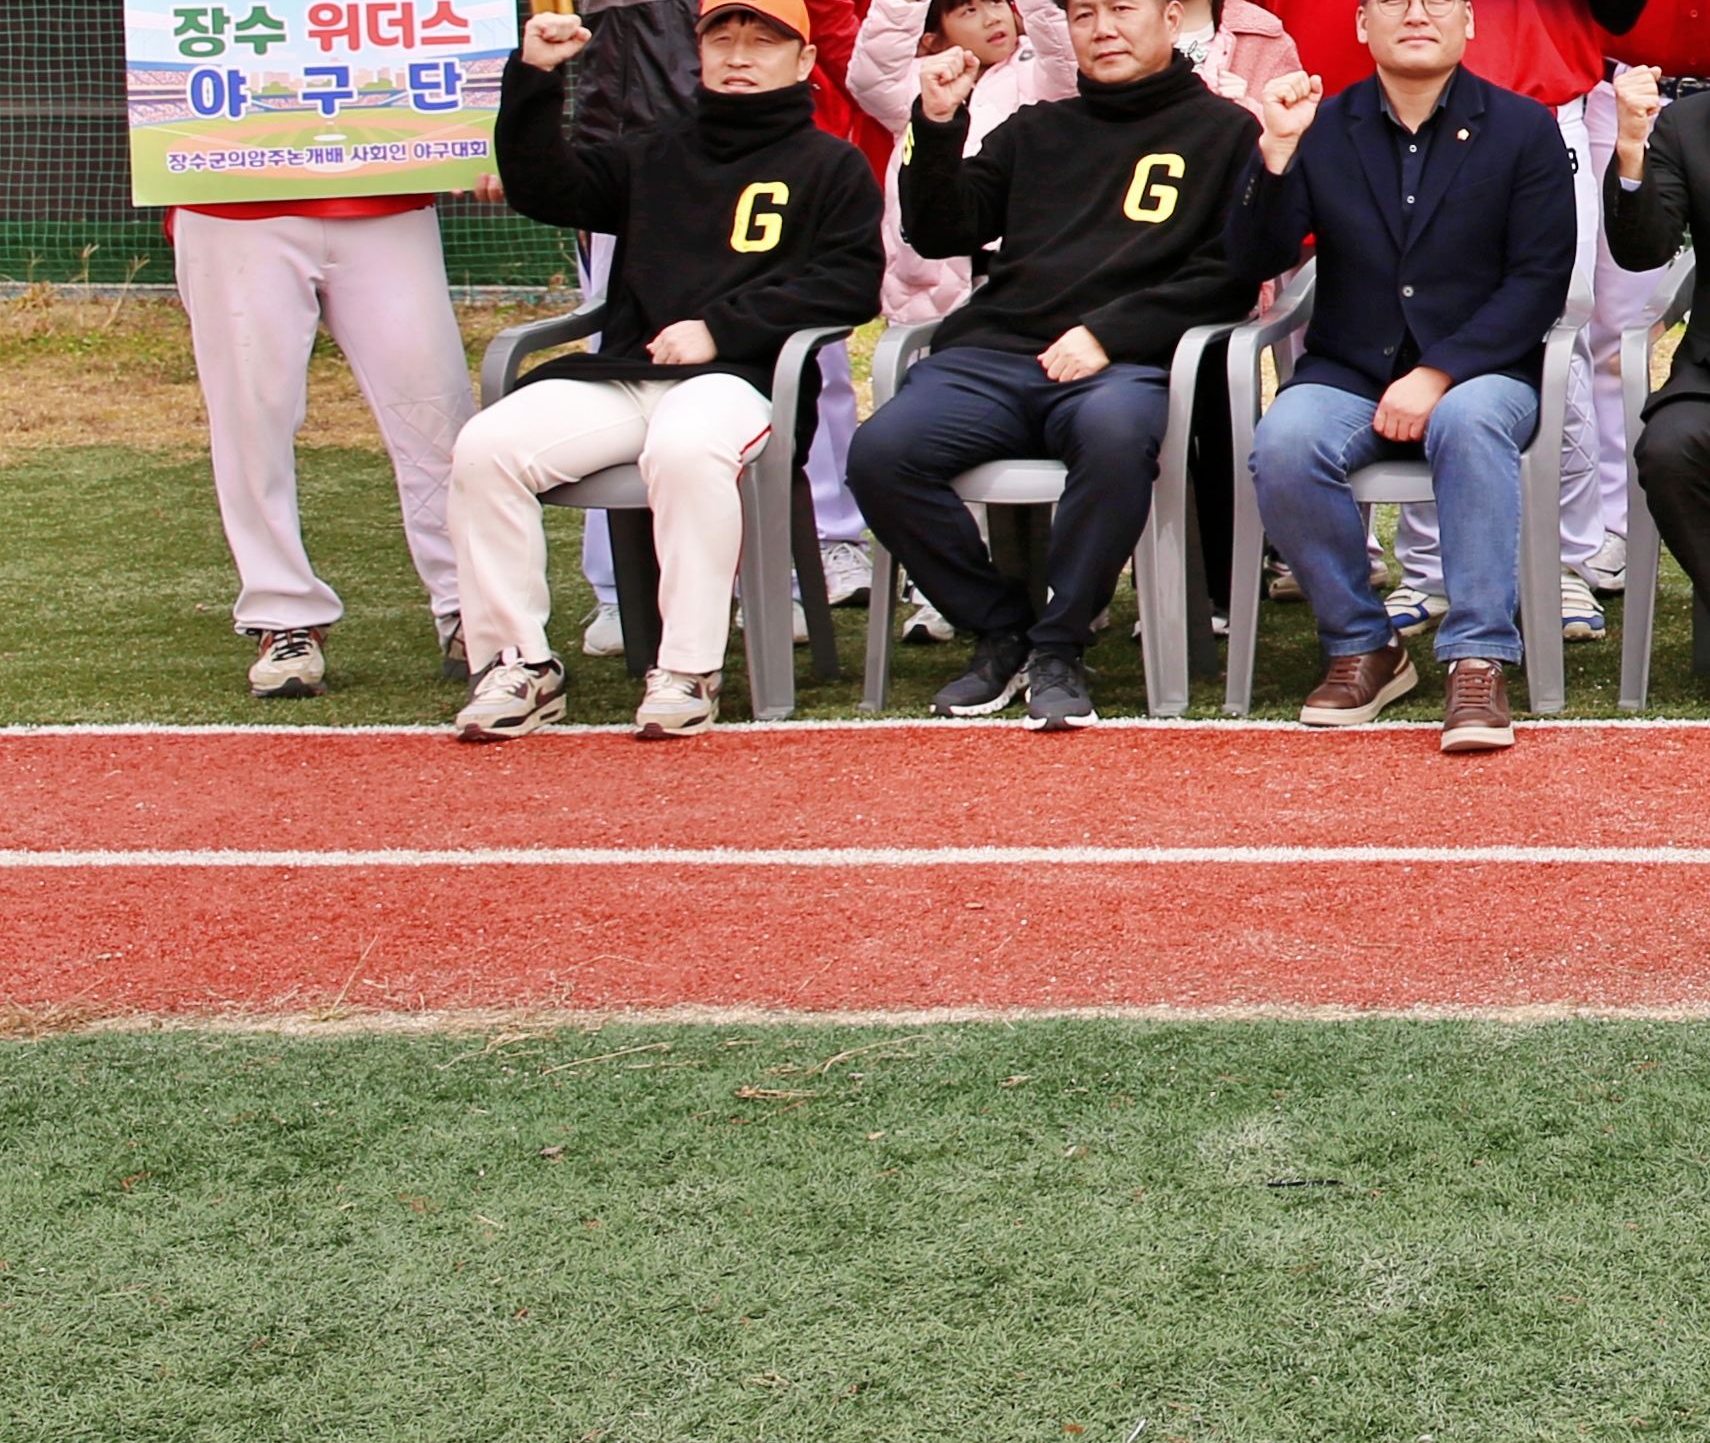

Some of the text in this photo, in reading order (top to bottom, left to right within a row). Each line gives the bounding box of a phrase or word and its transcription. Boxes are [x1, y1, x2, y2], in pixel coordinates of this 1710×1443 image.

[173, 0, 471, 58] 장수 위더스
[168, 140, 488, 171] 장수군의암주논개배 사회인 야구대회
[1123, 152, 1187, 224] G
[729, 180, 790, 254] G
